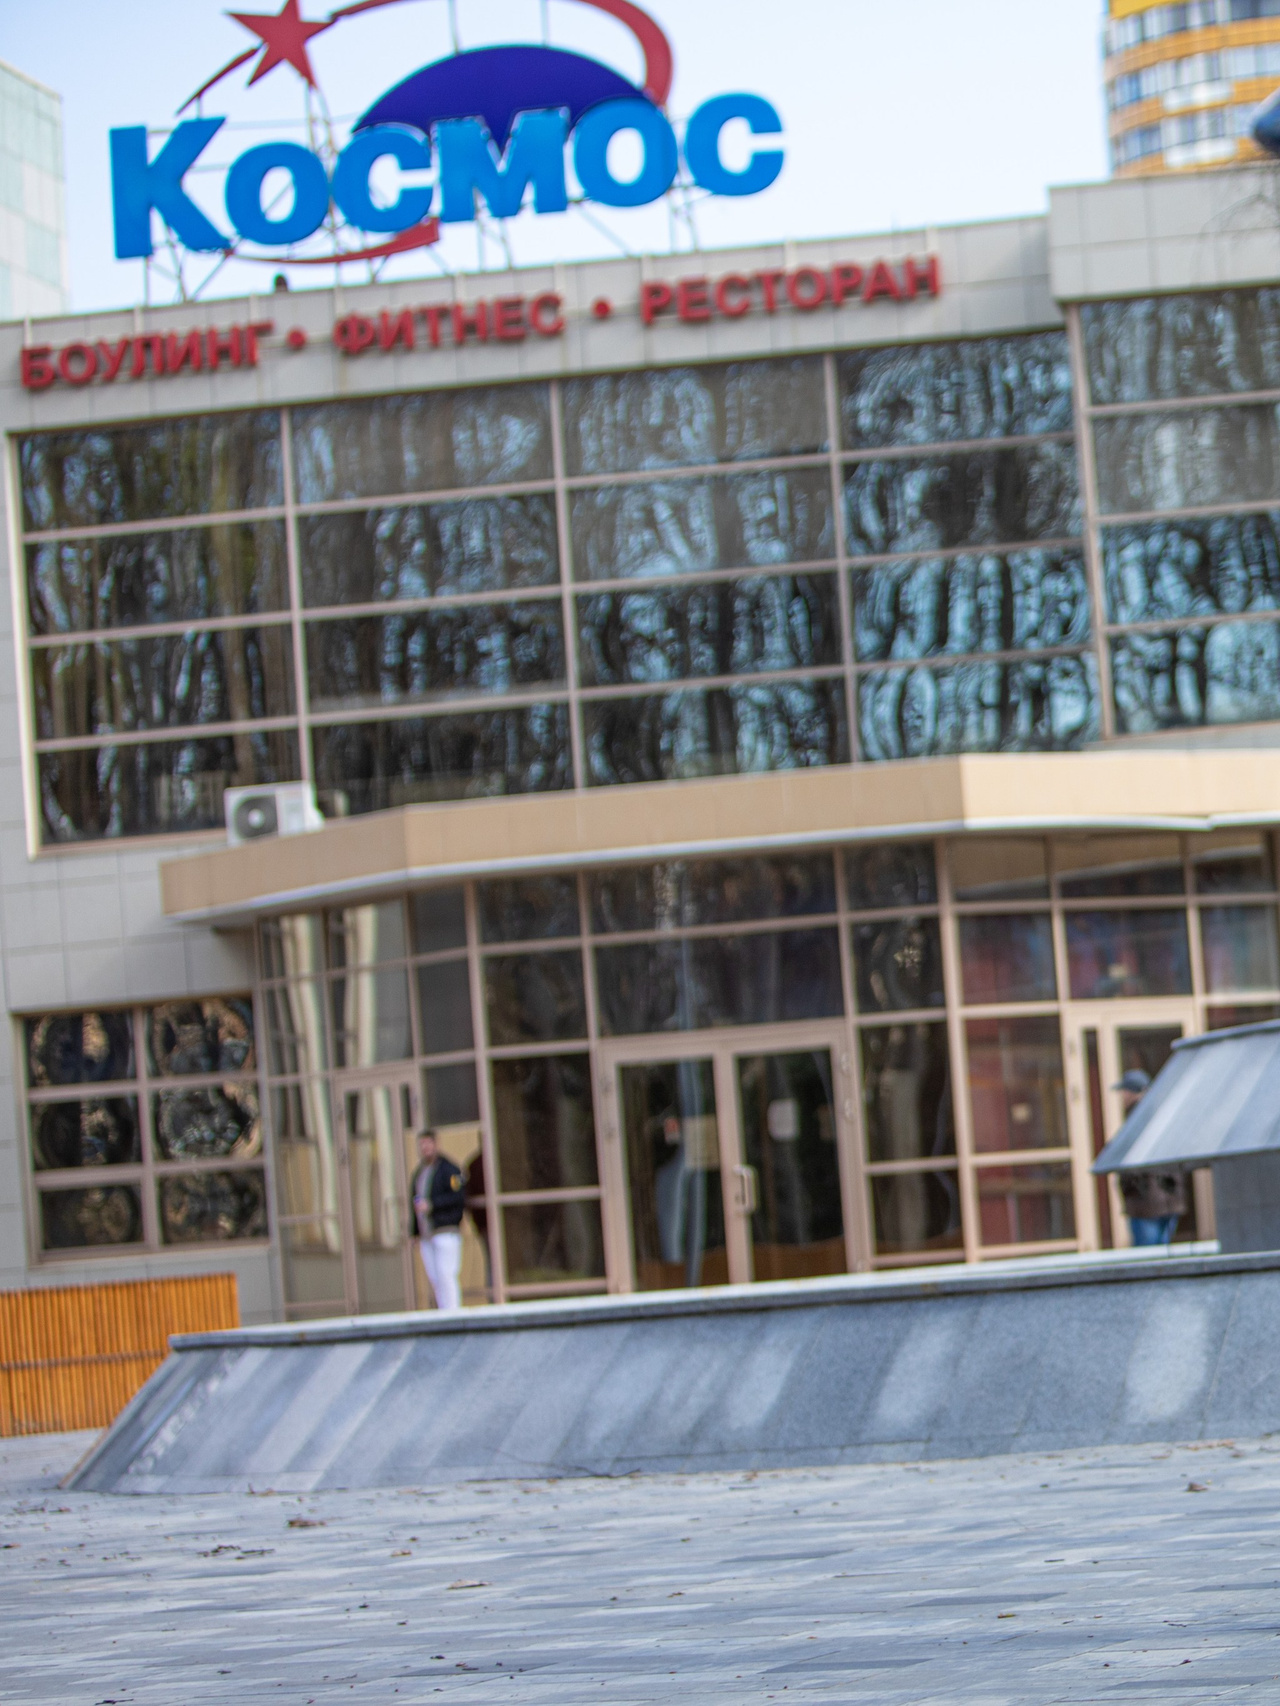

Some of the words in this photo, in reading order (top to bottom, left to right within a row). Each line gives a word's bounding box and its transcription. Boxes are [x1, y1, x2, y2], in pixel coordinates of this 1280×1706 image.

[19, 319, 274, 392] БОУЛИНГ
[333, 290, 566, 355] ФИТНЕС
[640, 253, 940, 326] РЕСТОРАН
